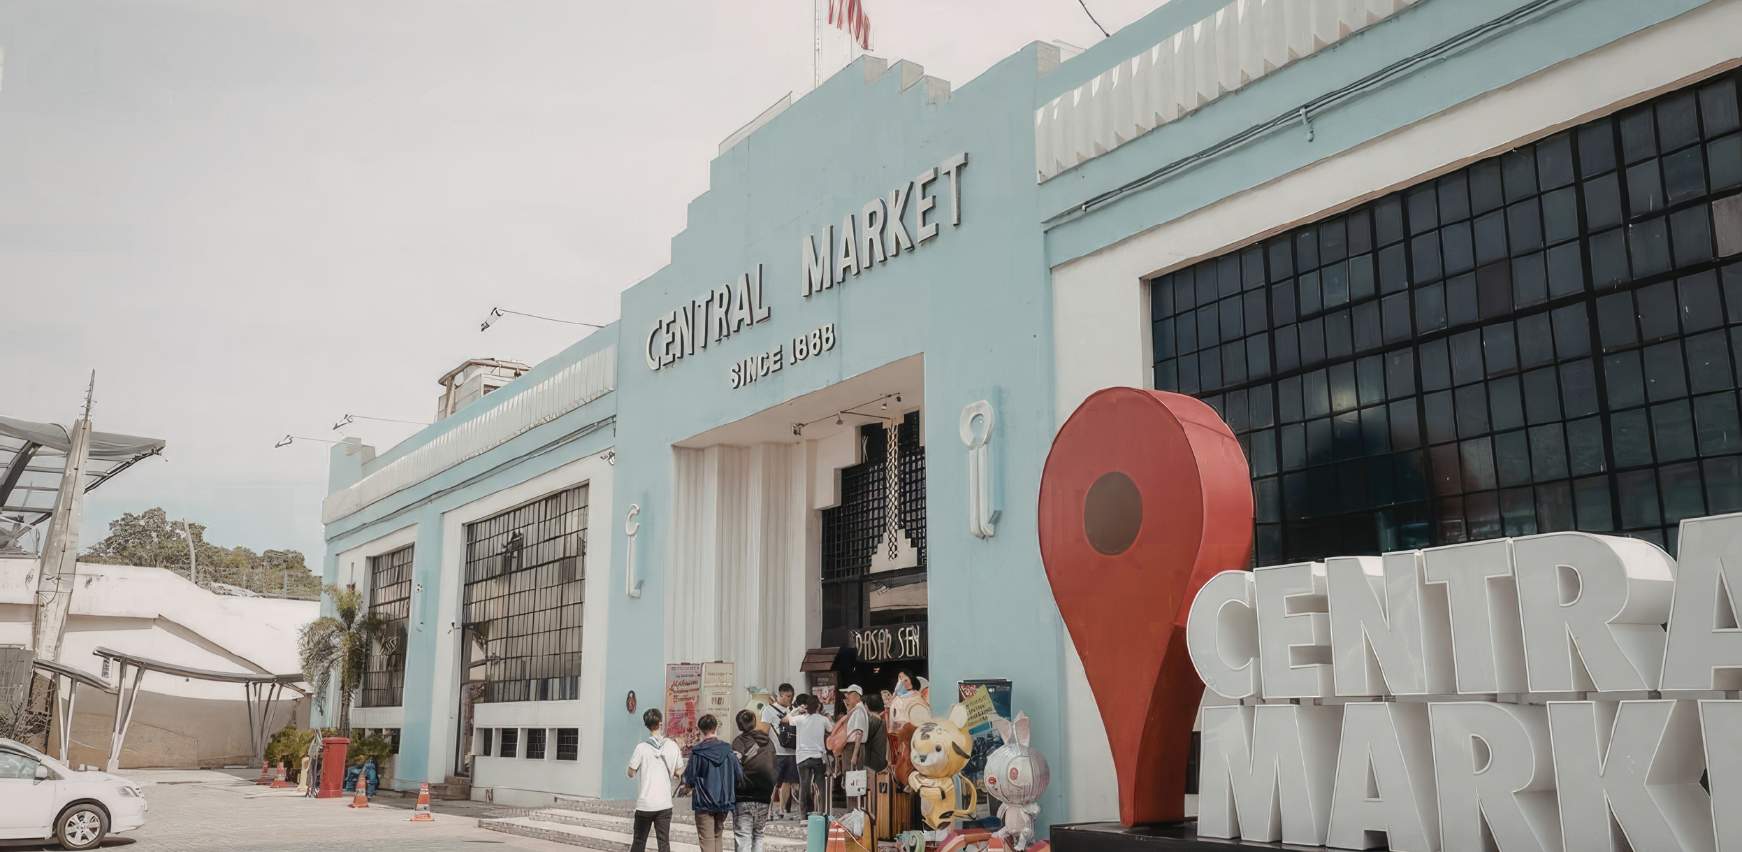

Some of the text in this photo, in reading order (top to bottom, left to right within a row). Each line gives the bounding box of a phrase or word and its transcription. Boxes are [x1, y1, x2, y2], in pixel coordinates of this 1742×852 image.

[646, 152, 968, 371] CENTRAL MARKET
[731, 324, 836, 389] SINCE 1888
